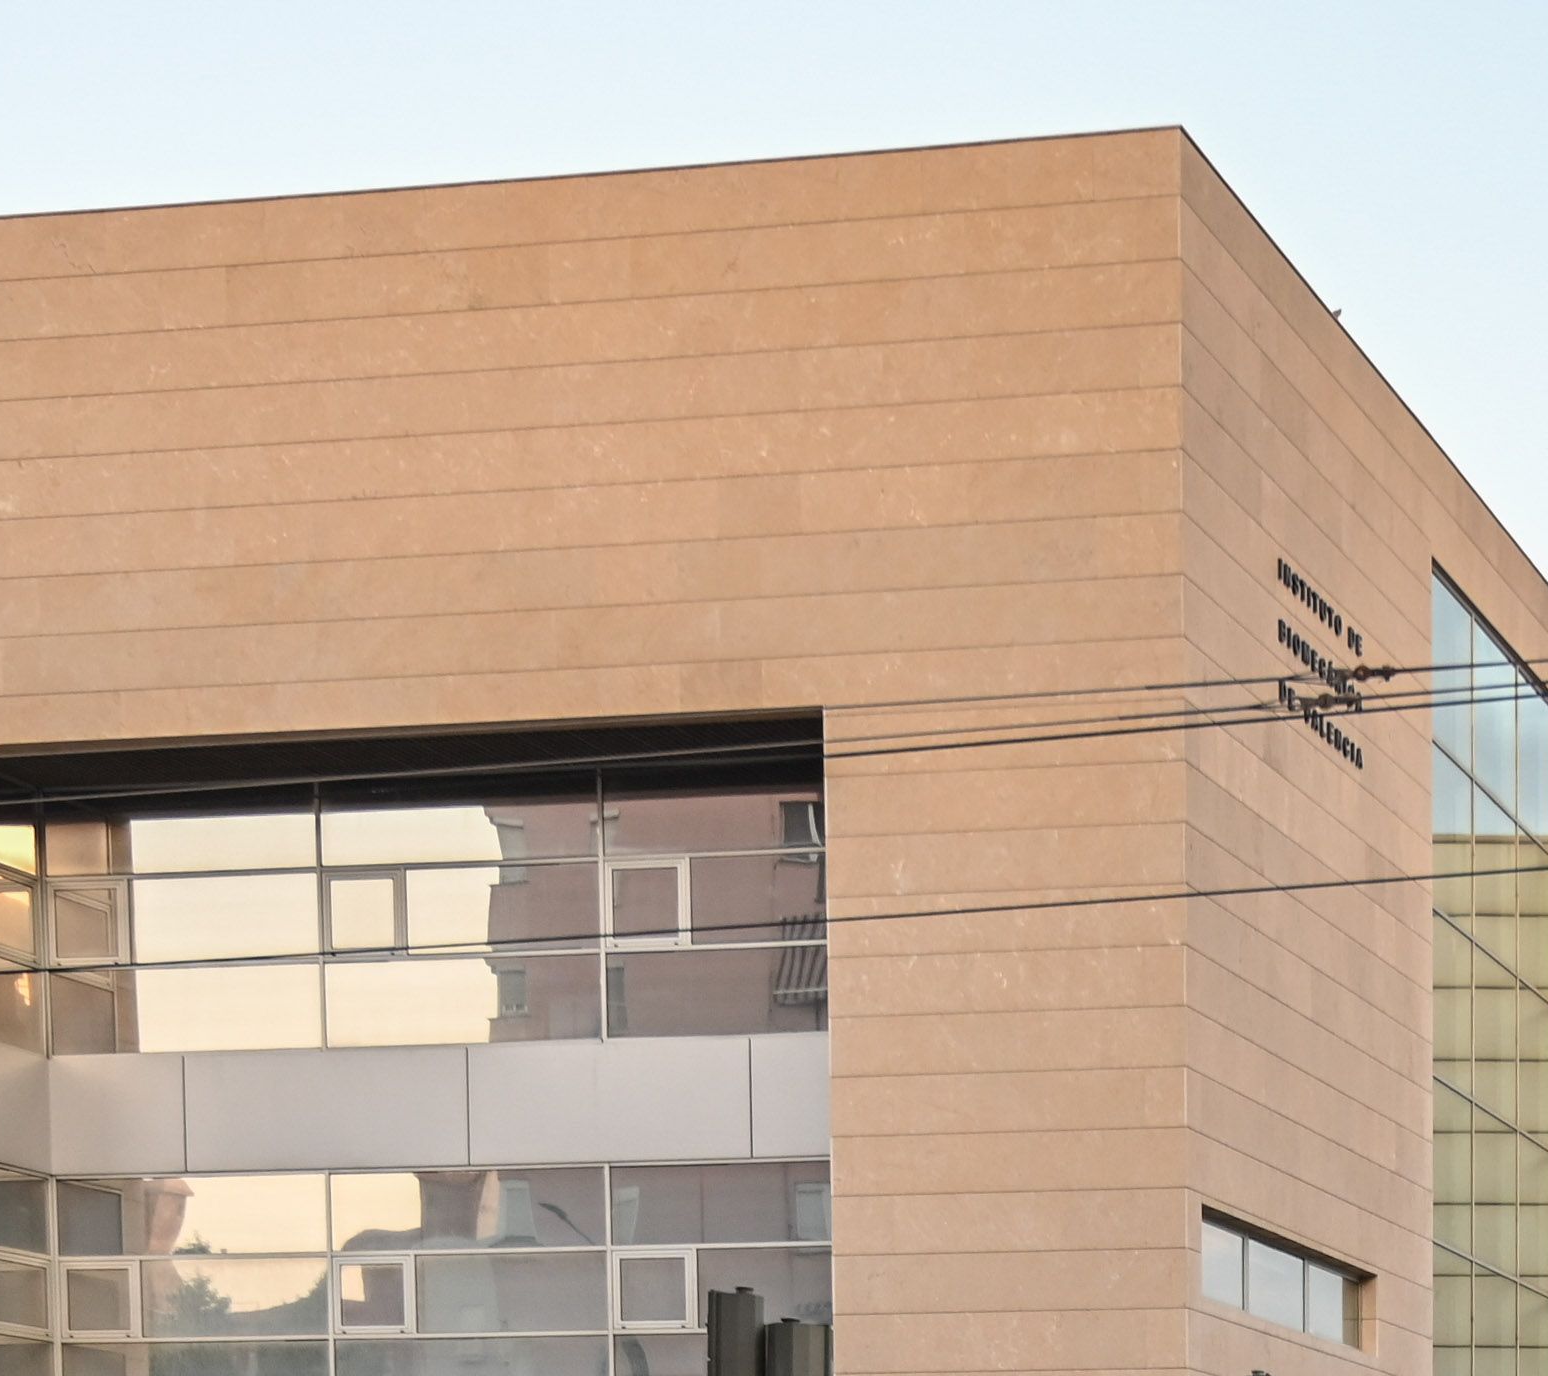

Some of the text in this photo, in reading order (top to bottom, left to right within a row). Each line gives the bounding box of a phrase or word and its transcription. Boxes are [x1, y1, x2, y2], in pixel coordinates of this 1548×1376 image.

[1277, 558, 1363, 657] INSTITUTO DE
[1278, 679, 1296, 711] DE
[1303, 704, 1363, 770] VALENCIA
